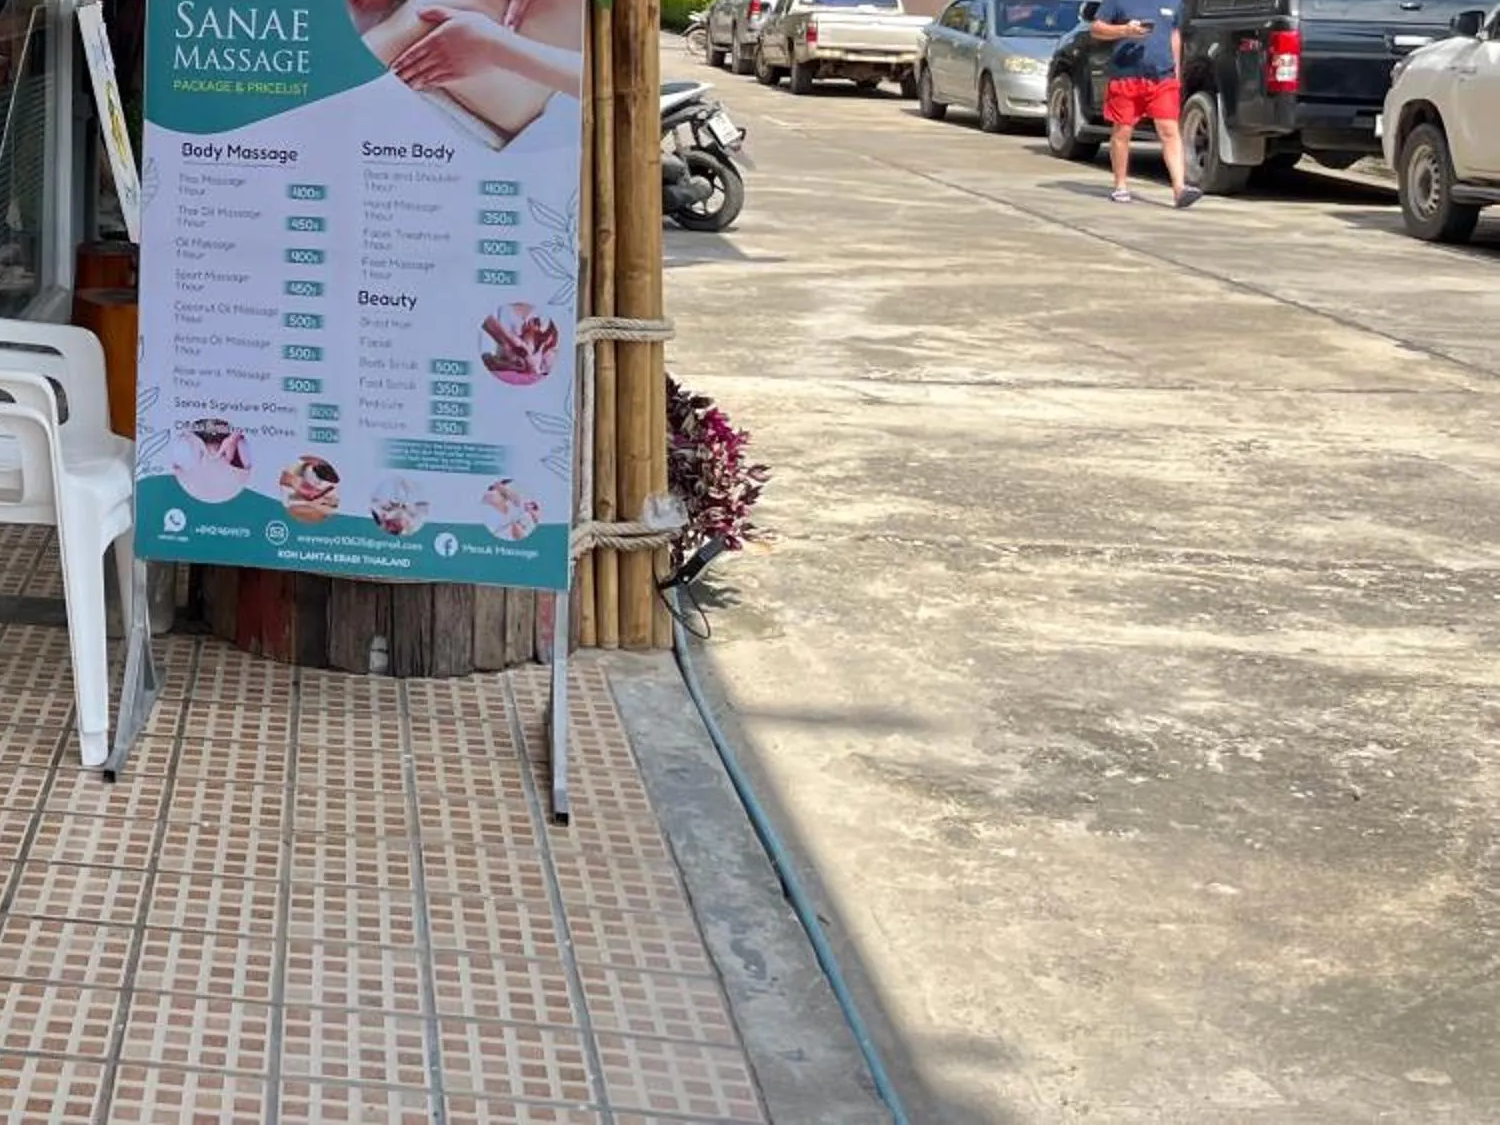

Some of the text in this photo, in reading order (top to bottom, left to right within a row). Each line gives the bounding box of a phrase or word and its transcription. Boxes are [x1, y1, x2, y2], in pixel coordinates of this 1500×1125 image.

[175, 0, 309, 41] SANAE
[173, 44, 310, 73] MASSAGE
[173, 79, 233, 92] PACKAGE
[182, 142, 299, 164] Body Massage
[361, 141, 456, 163] Some Body
[358, 290, 417, 310] Beauty
